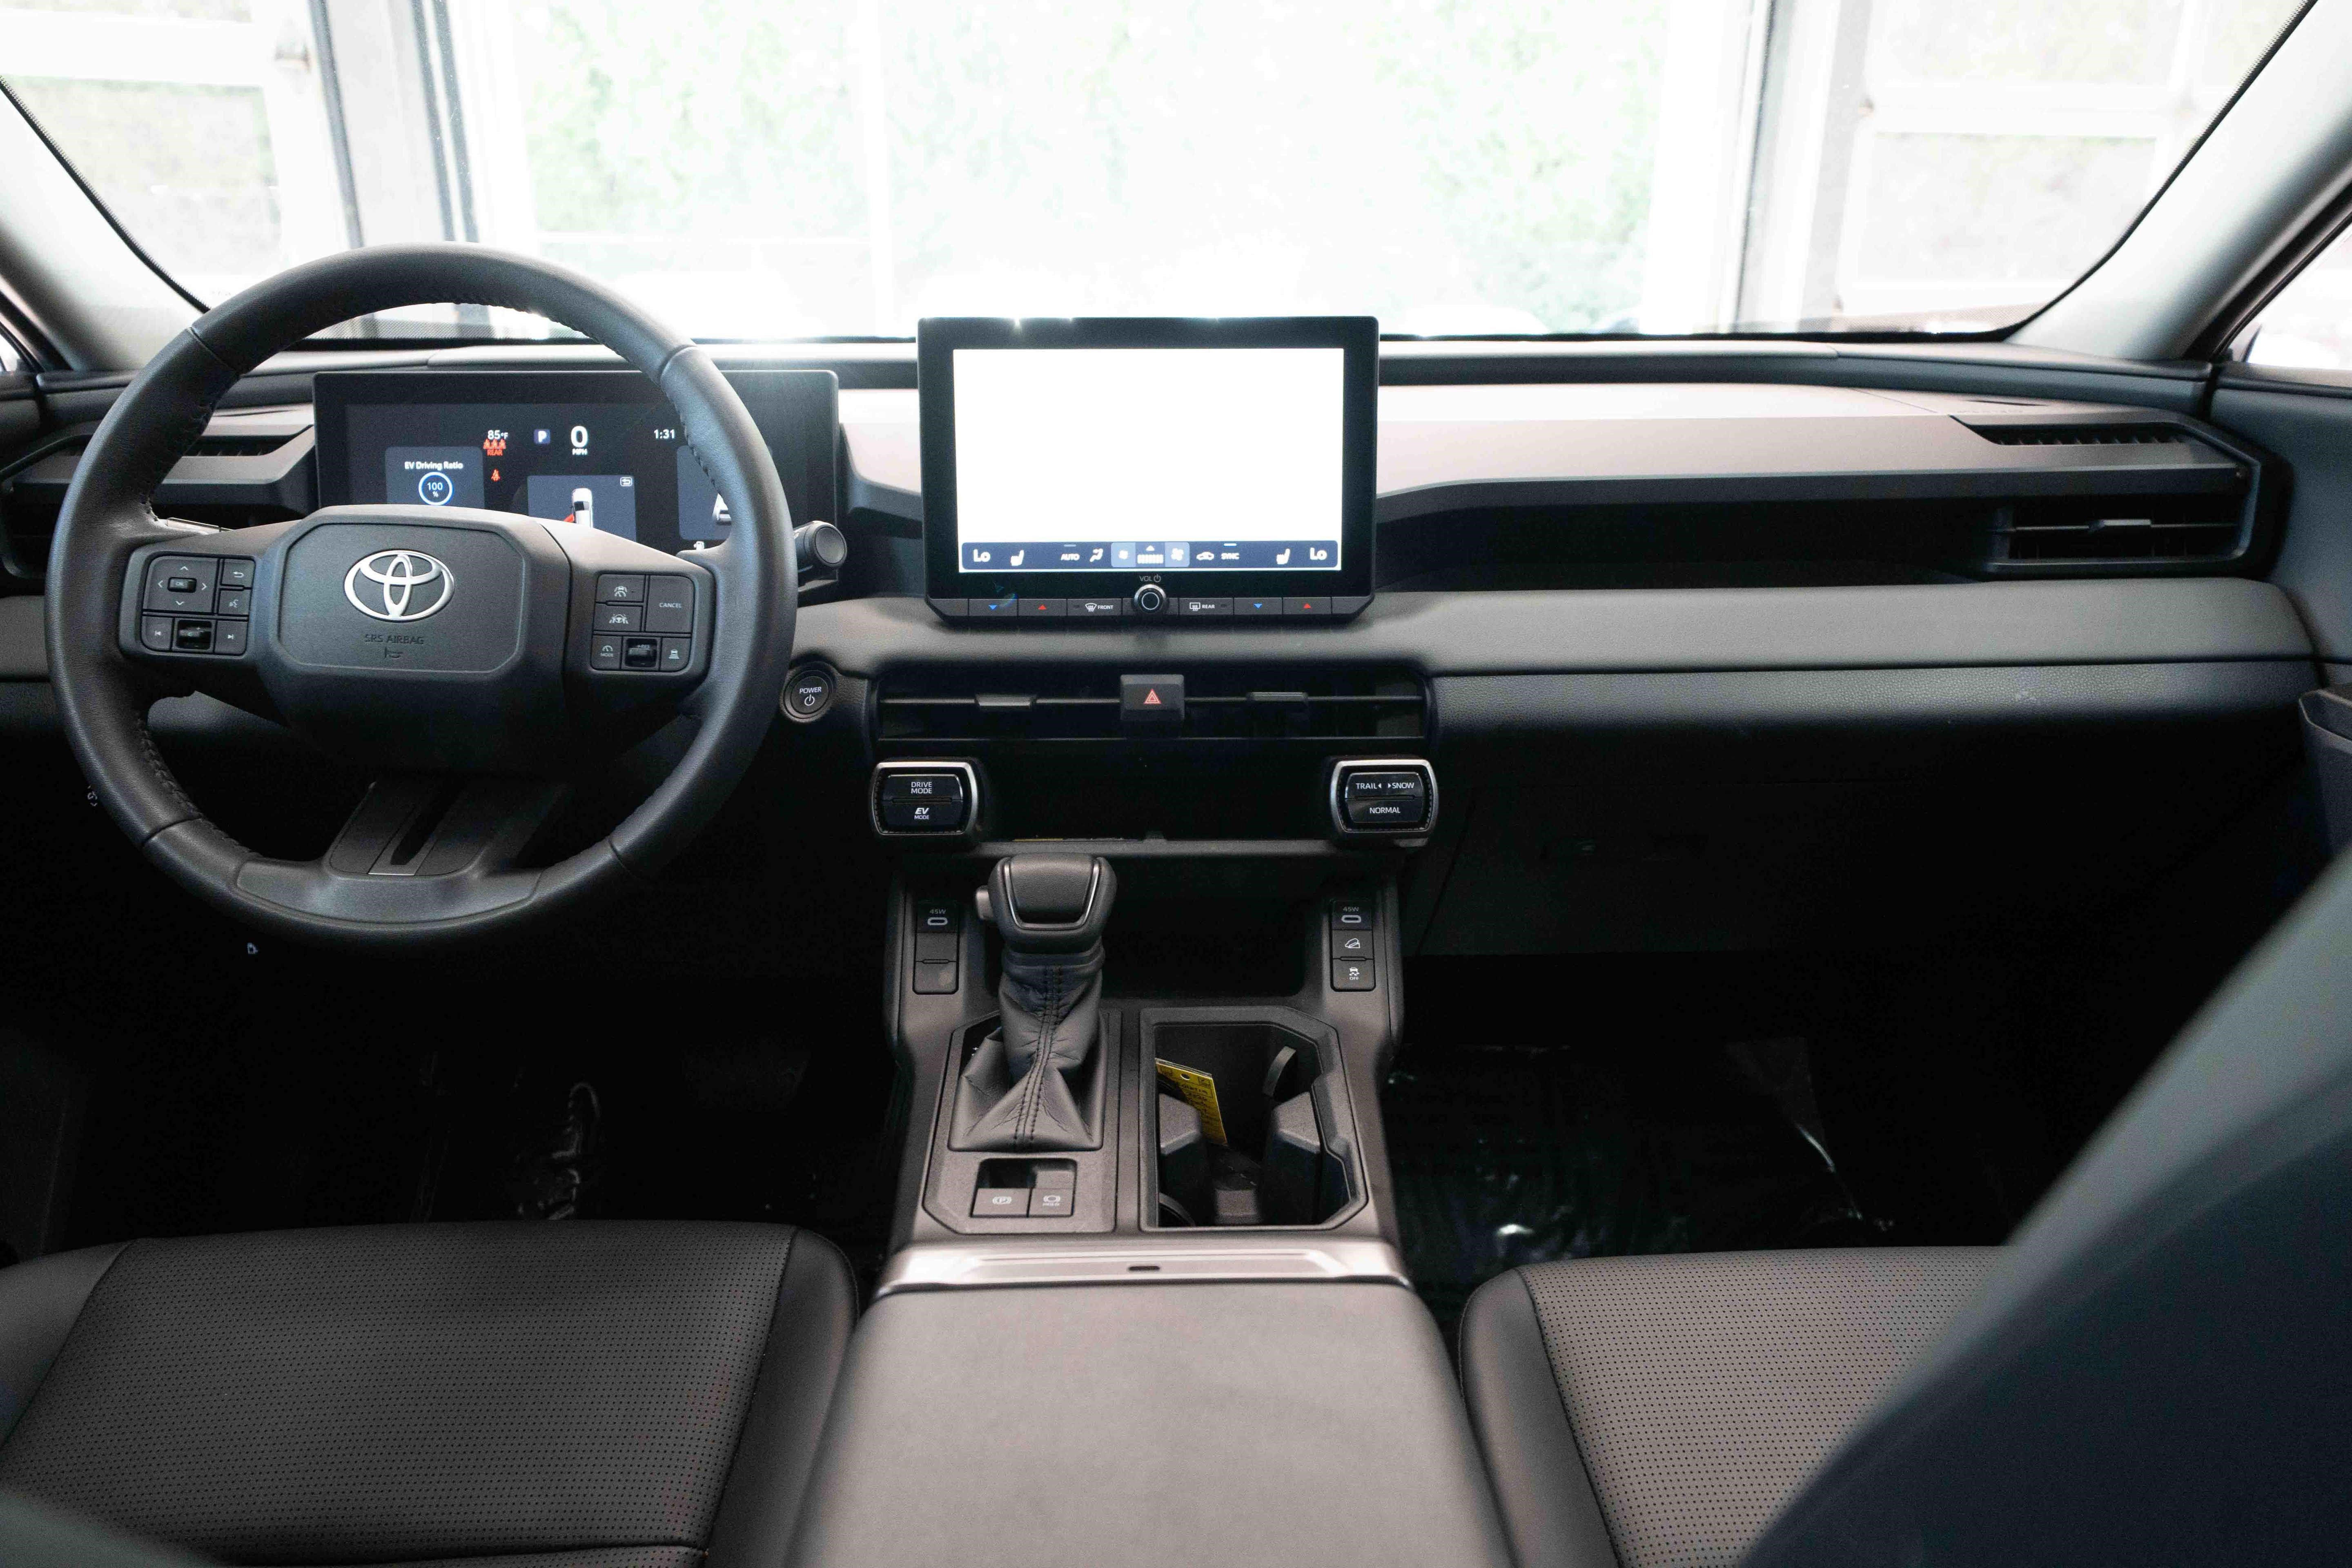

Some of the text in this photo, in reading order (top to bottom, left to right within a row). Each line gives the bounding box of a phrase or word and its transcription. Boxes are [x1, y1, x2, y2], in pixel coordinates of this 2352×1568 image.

[538, 430, 547, 443] P
[571, 425, 588, 448] 0
[654, 429, 675, 439] 1:31
[416, 461, 443, 470] Driving
[443, 461, 464, 469] Ratio
[427, 482, 443, 490] 100
[364, 634, 424, 644] SRS AIRBAG
